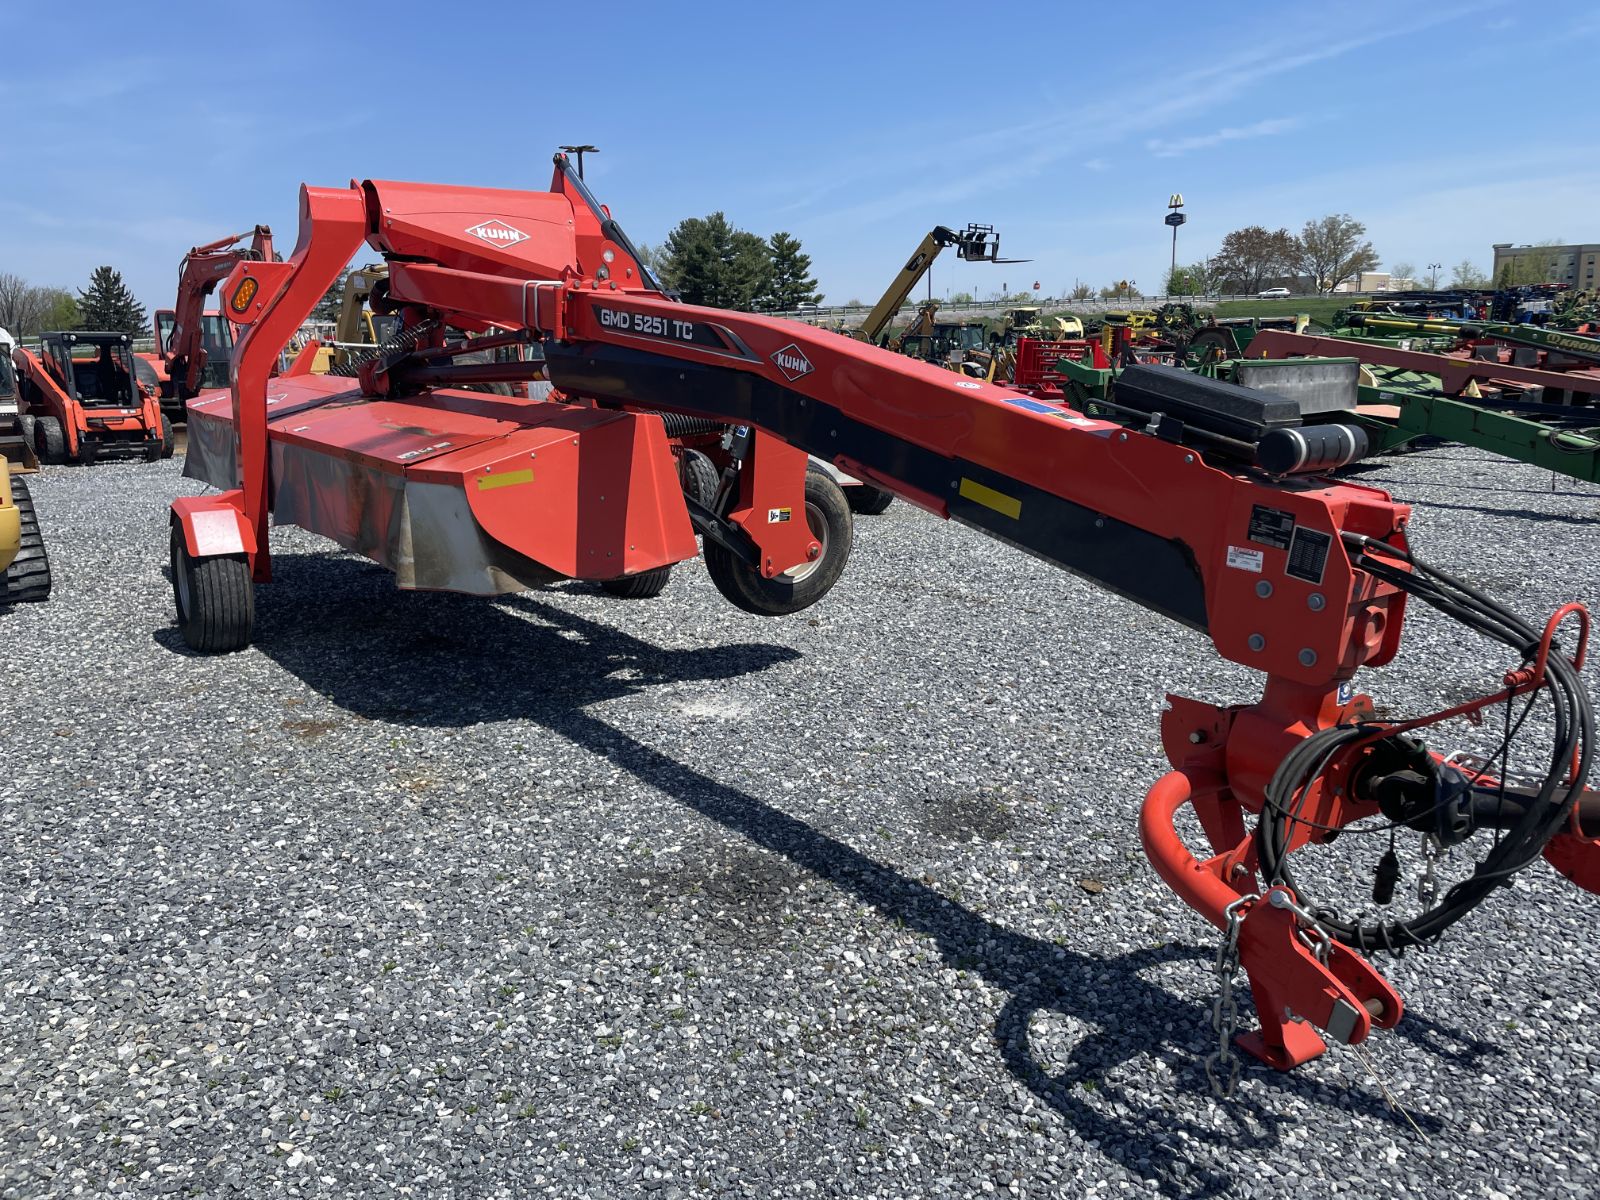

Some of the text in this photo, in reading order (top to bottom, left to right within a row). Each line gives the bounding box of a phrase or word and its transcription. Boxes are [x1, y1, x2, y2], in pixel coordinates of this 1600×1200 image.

[476, 227, 520, 241] KUHN
[601, 309, 693, 340] GMD 5251 TC
[1559, 338, 1600, 353] KRON
[777, 353, 807, 373] KUHN
